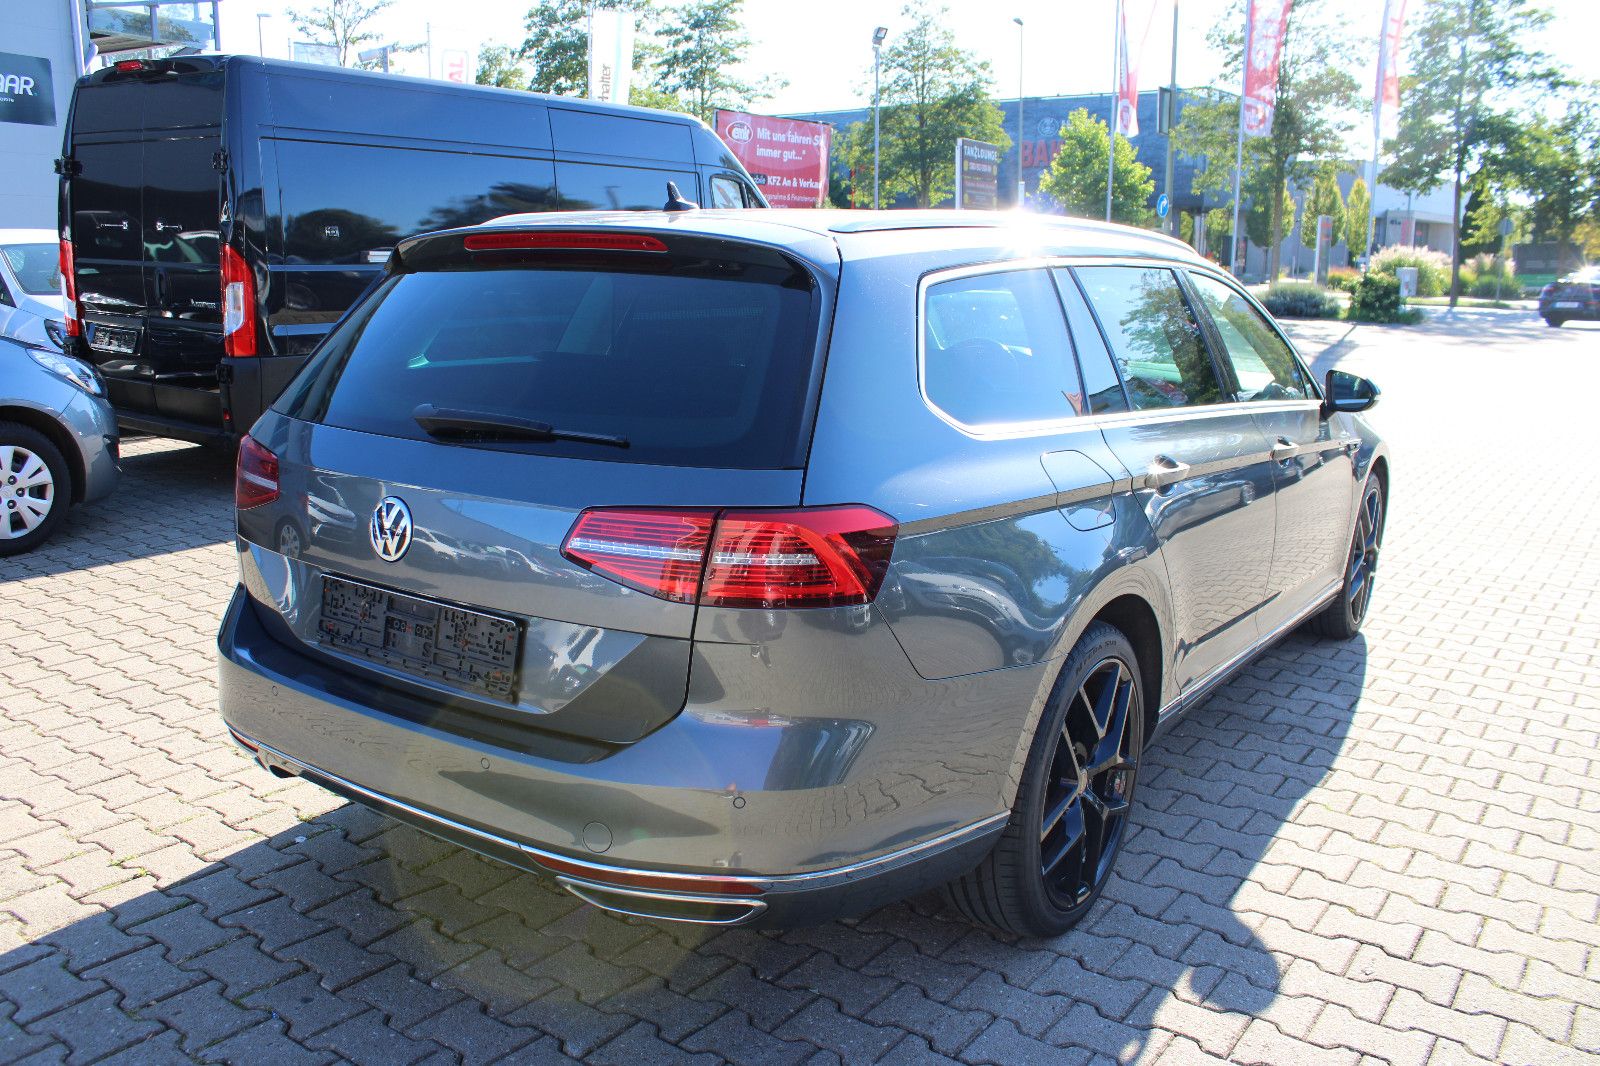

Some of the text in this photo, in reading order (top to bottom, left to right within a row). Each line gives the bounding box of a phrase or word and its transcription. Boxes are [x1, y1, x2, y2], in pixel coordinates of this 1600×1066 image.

[597, 64, 611, 101] halter
[757, 128, 770, 140] Mit
[787, 131, 811, 145] fahren
[757, 145, 781, 158] immer
[767, 175, 782, 186] KFZ
[799, 178, 822, 189] Verkau
